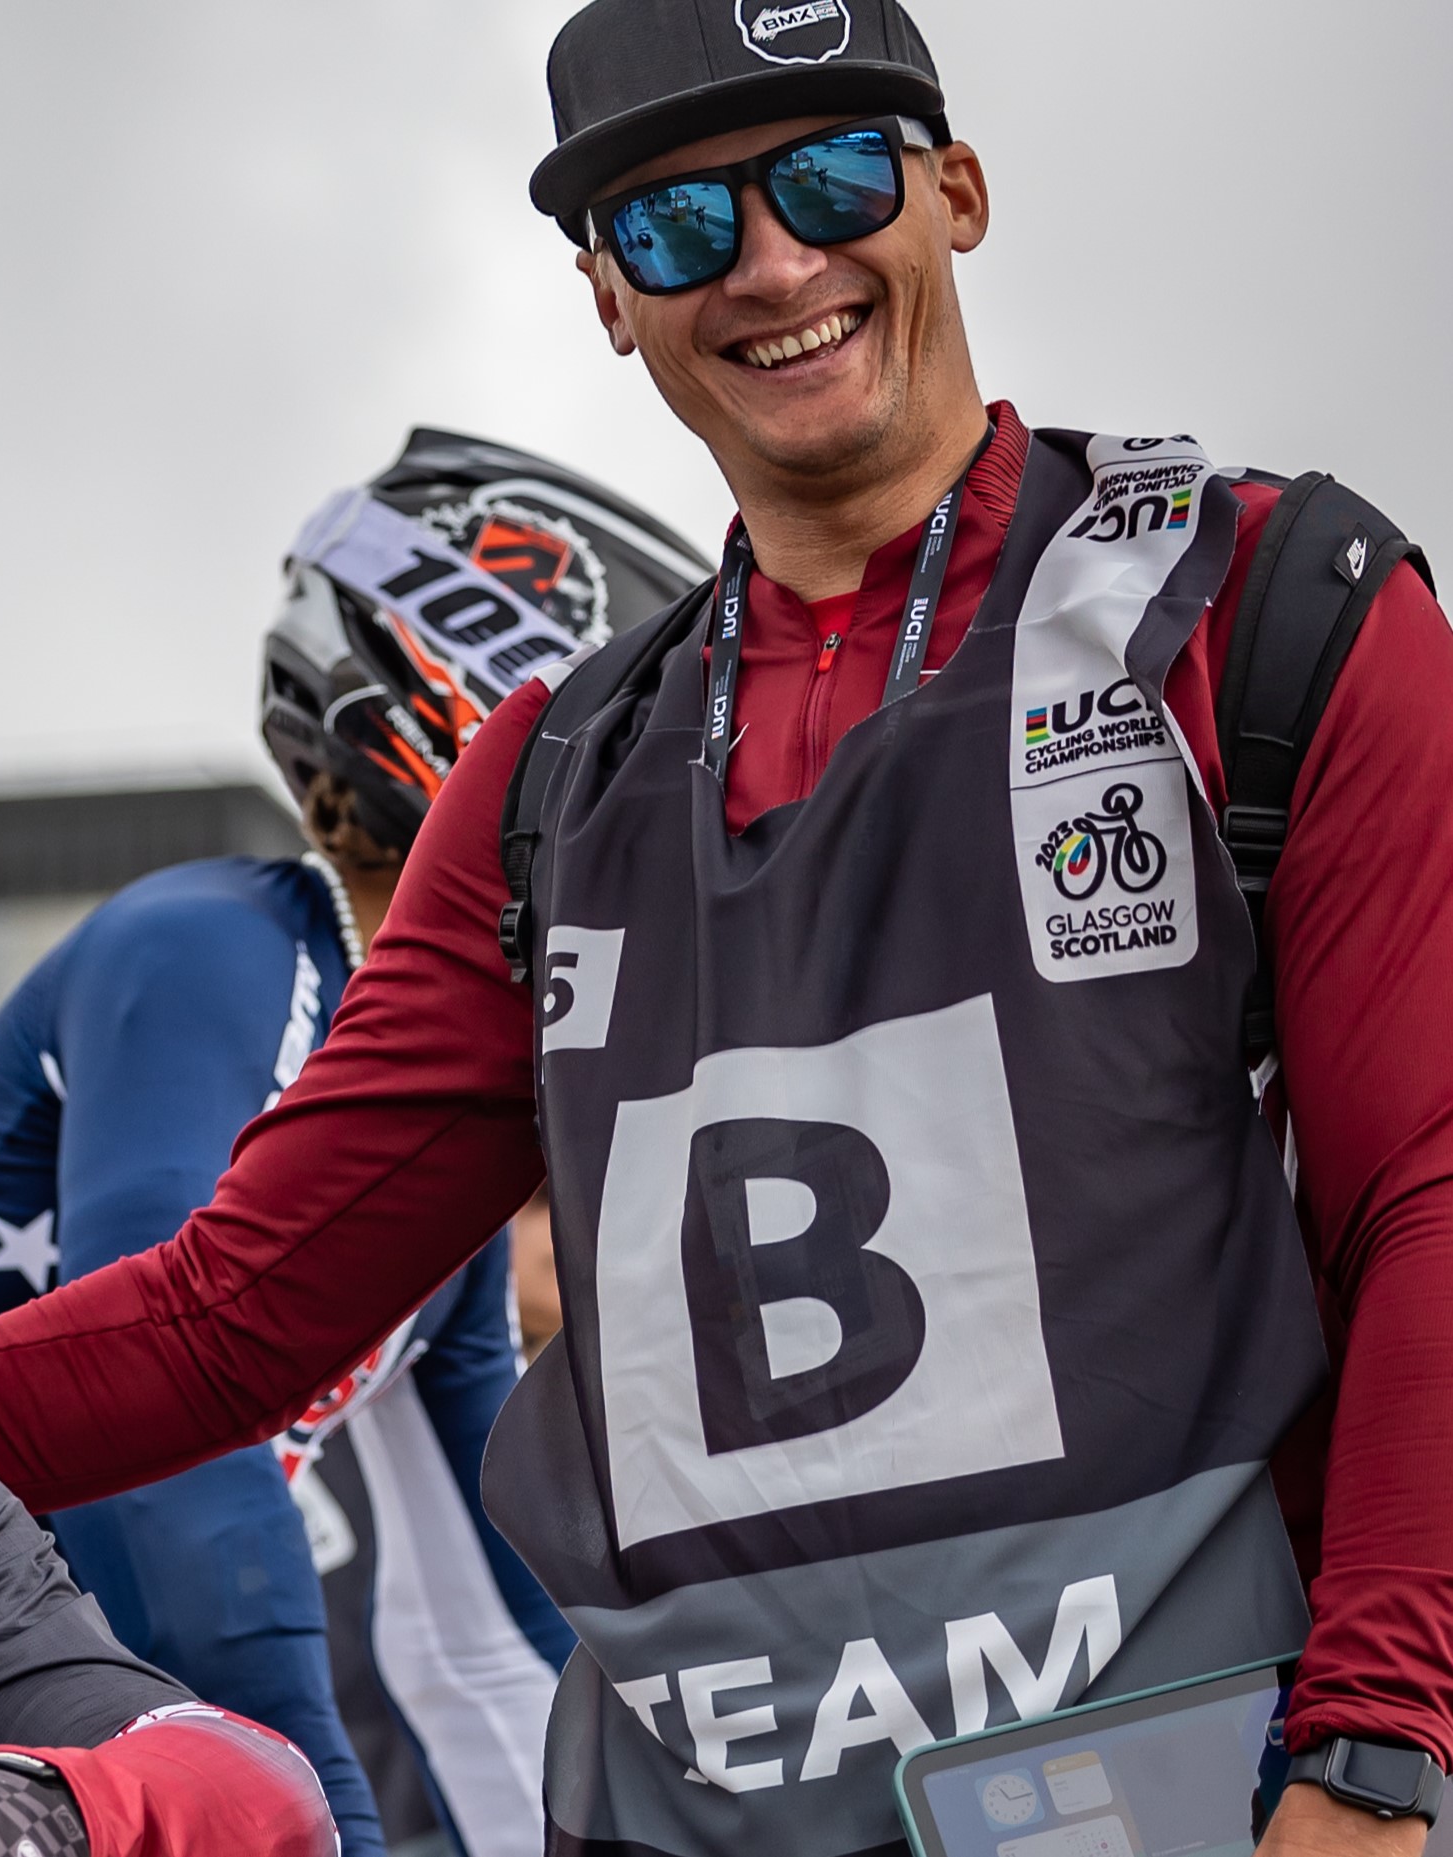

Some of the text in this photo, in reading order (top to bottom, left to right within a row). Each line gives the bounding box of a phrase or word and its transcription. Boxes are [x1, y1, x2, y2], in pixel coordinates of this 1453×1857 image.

[762, 8, 813, 31] BMX
[1134, 474, 1197, 494] CYCLING
[930, 497, 949, 535] UCI
[1066, 495, 1168, 542] UCI
[724, 597, 739, 632] UCI
[905, 606, 925, 641] UCI
[713, 695, 727, 733] UCI
[1052, 677, 1154, 734] UC
[1025, 716, 1163, 761] CYCLING WORLD
[1025, 732, 1165, 774] CHAMPIONSHIPS
[1035, 821, 1074, 872] 2023
[1046, 899, 1175, 936] GLASGOW
[1050, 925, 1177, 959] SCOTLAND
[681, 1117, 926, 1456] B
[612, 1574, 1122, 1793] TEAM
